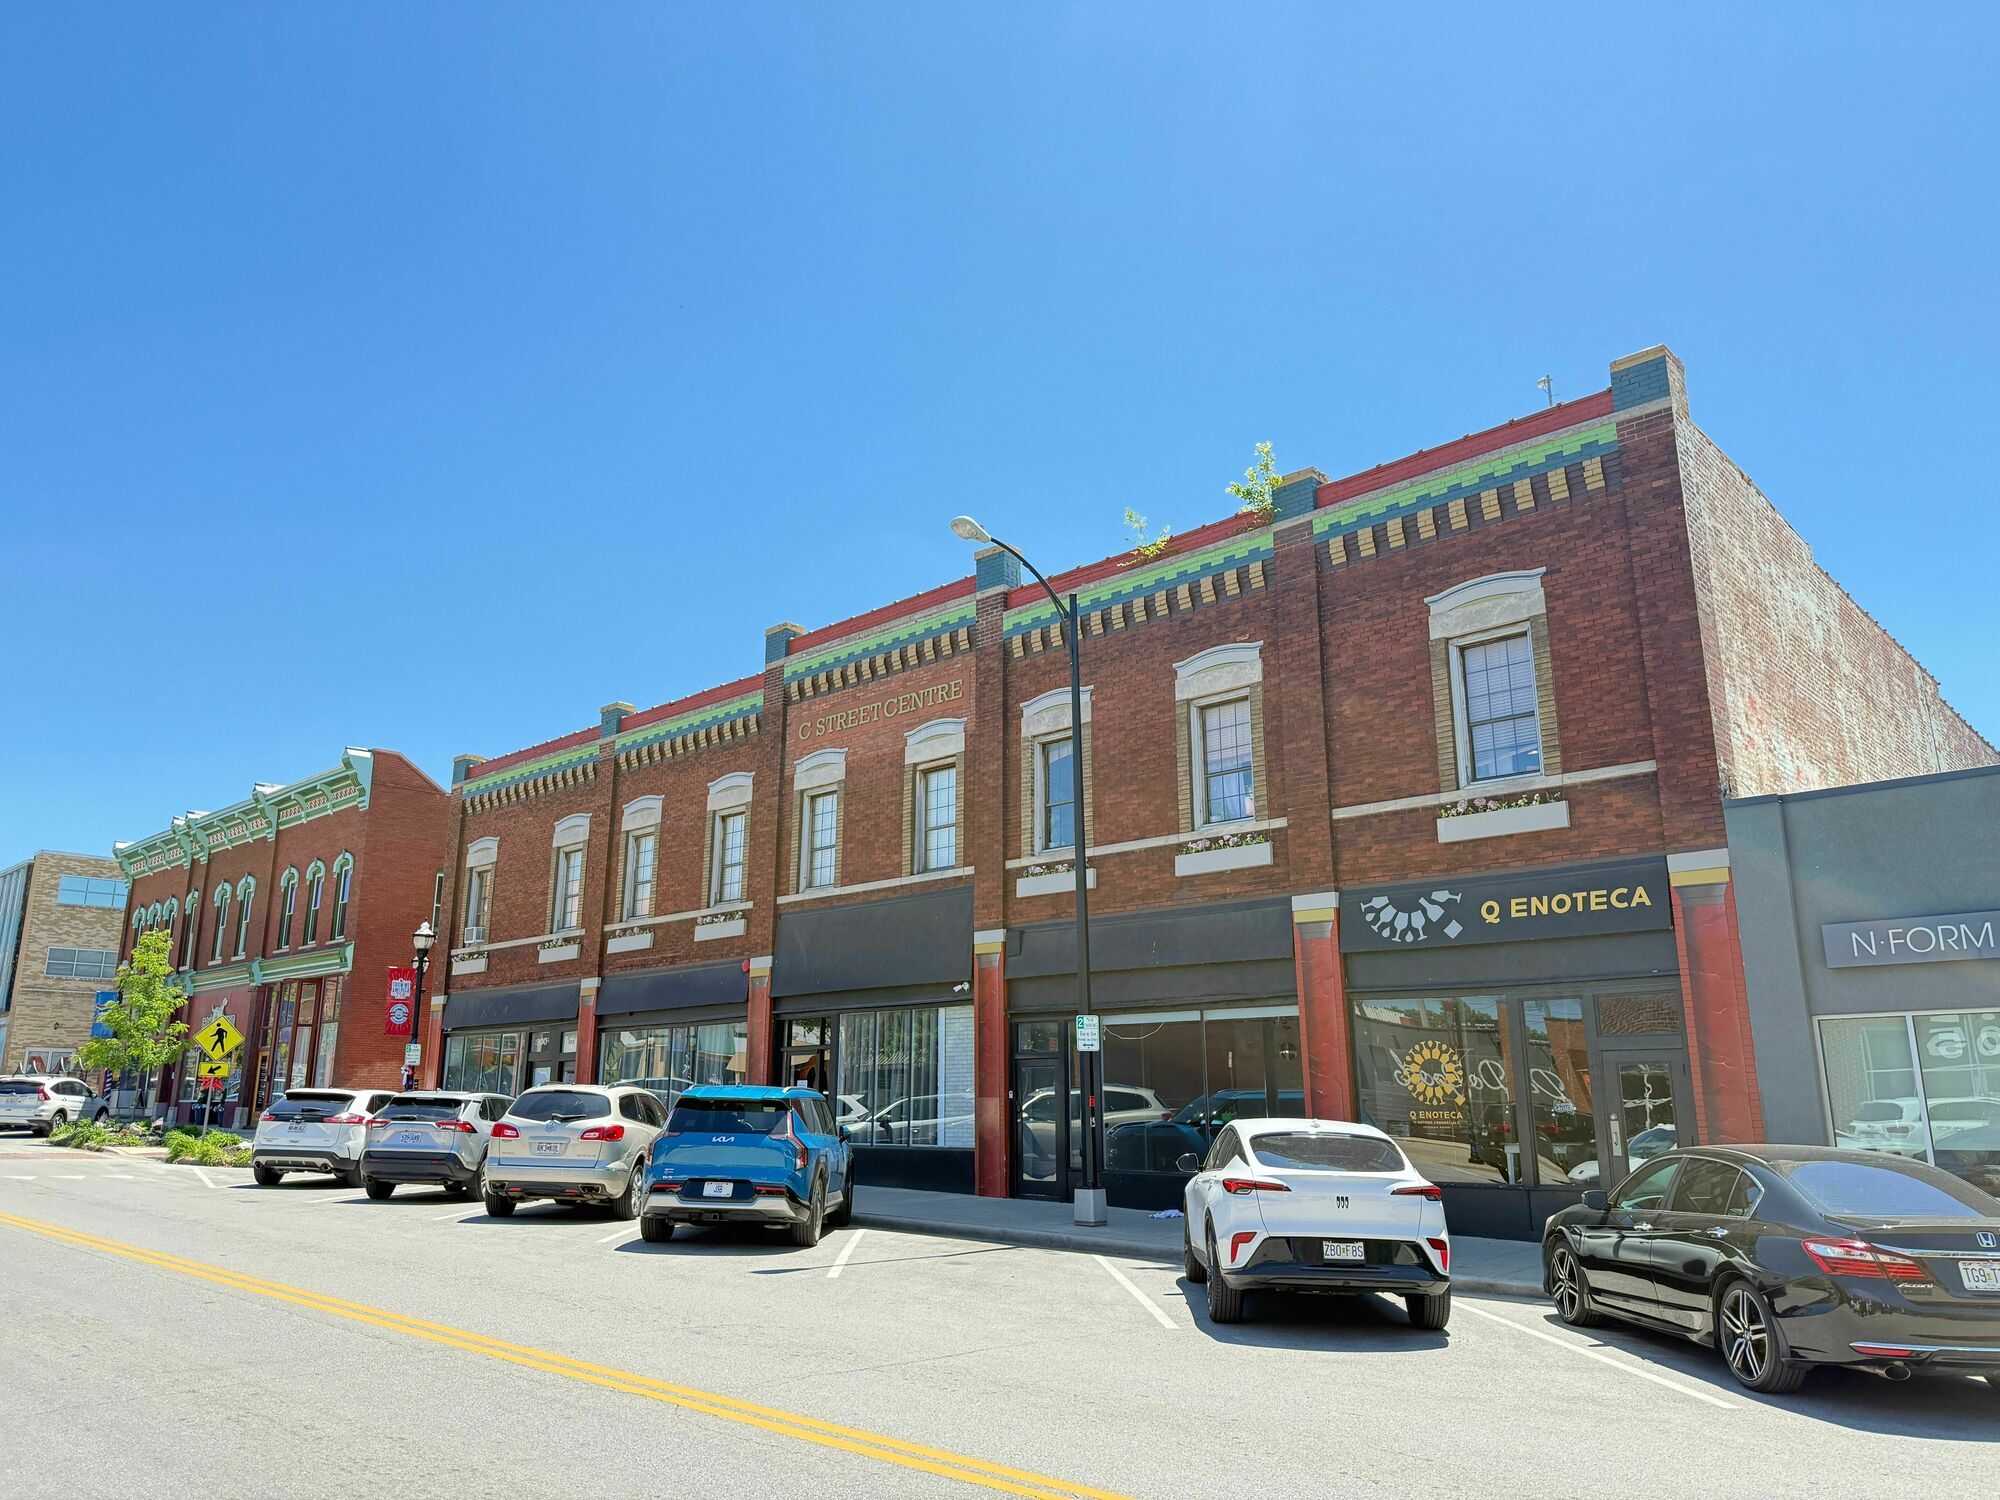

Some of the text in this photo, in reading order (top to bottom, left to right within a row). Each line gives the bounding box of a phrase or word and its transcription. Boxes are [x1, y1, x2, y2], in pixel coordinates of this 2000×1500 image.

[799, 679, 963, 740] C STREET CENTRE
[1480, 886, 1652, 924] Q ENOTECA
[1409, 1110, 1463, 1120] Q ENOTECA
